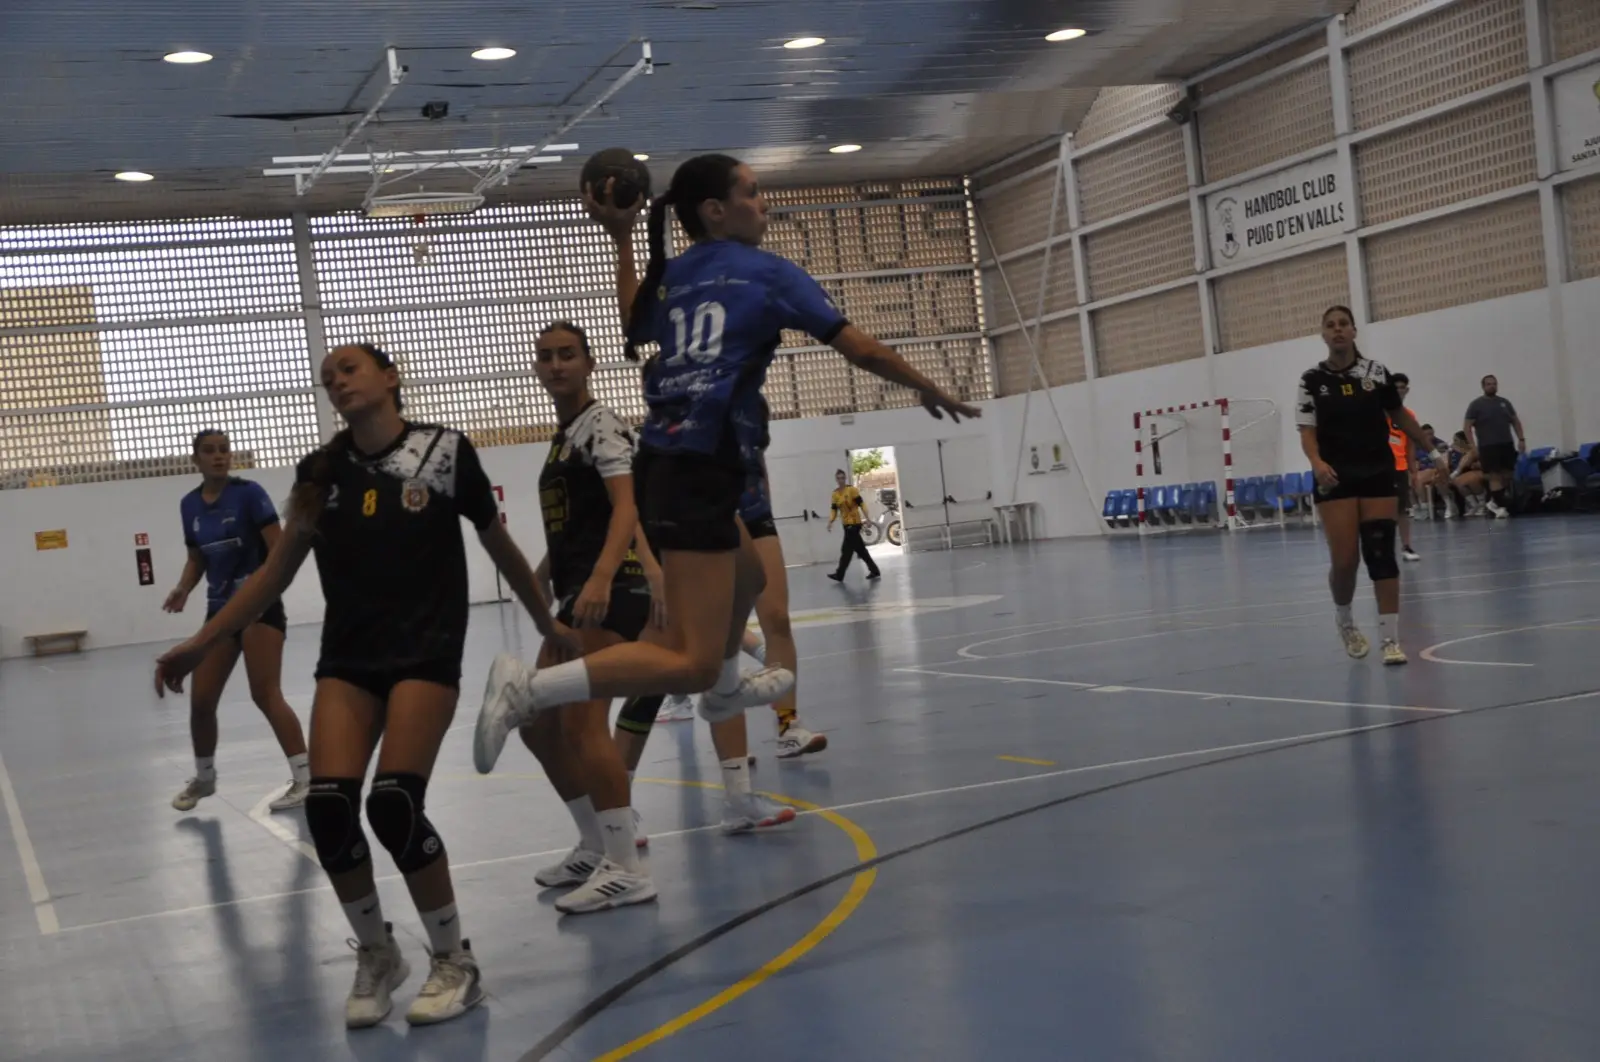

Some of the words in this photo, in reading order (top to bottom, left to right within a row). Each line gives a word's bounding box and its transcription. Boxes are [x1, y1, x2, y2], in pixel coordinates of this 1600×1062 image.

[1244, 185, 1300, 219] HANDBOL
[1302, 174, 1336, 201] CLUB
[1247, 223, 1274, 247] PUIG
[1276, 215, 1305, 239] D'EN
[1307, 201, 1345, 230] VALLS
[665, 300, 726, 367] 10
[362, 488, 378, 517] 8
